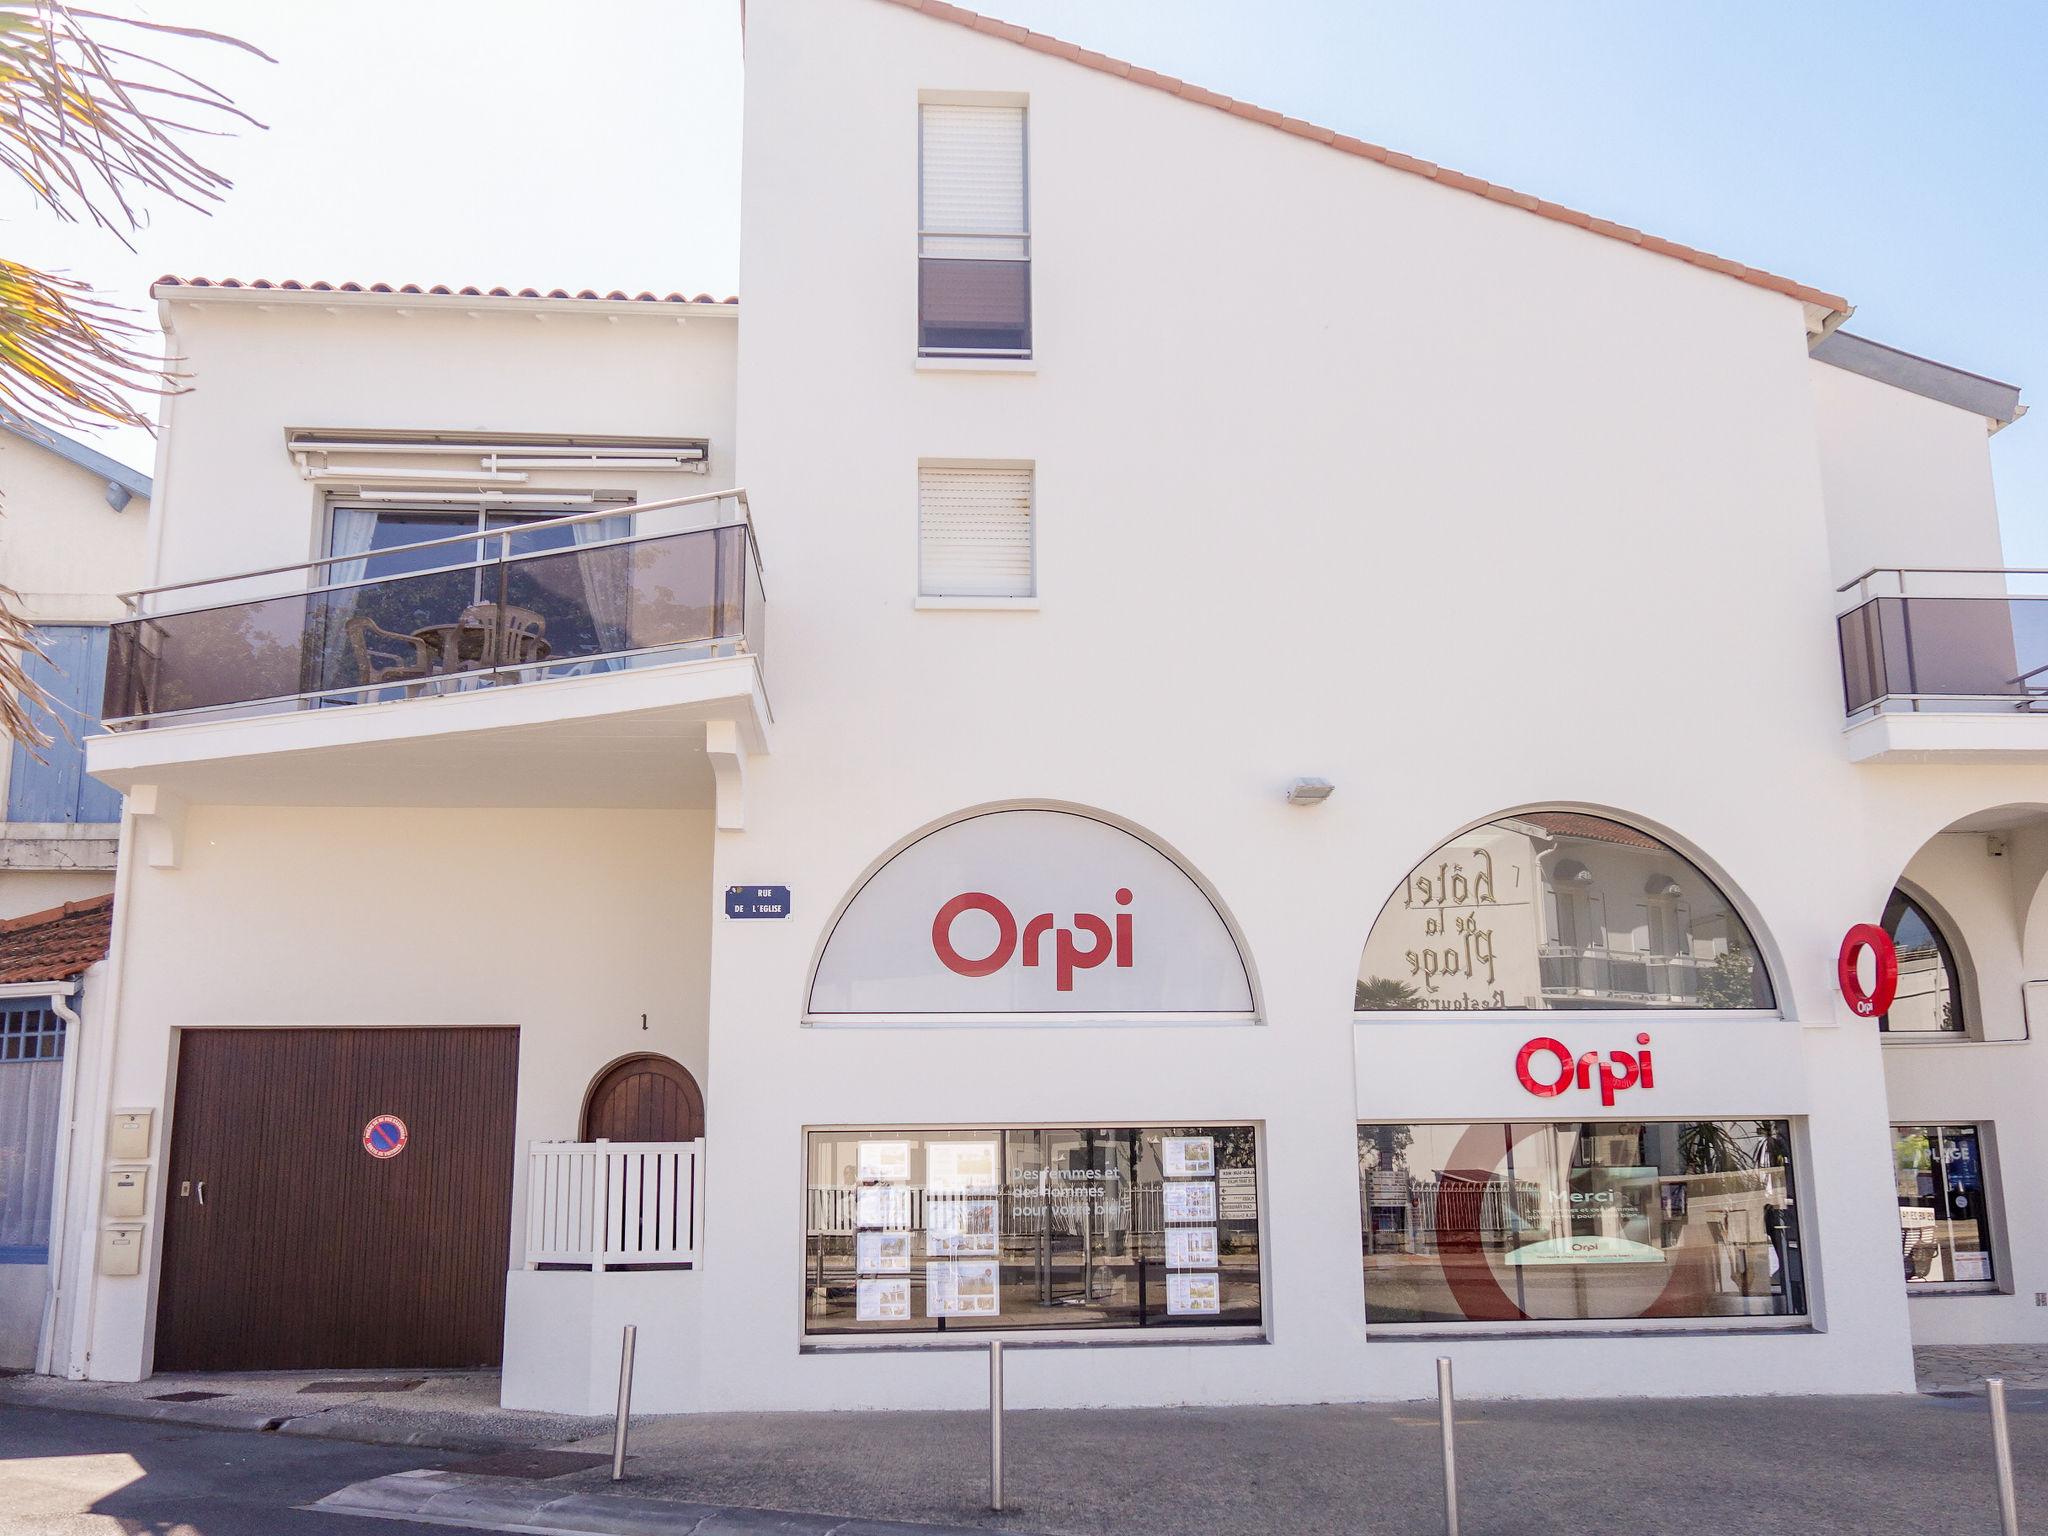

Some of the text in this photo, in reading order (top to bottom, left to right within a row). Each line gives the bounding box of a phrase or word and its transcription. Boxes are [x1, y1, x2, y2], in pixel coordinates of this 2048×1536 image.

[757, 888, 772, 898] RUE
[734, 904, 782, 913] DE L'EGLISE
[932, 888, 1134, 991] Orpi
[641, 1013, 649, 1031] 1
[1515, 1032, 1655, 1107] Orpi
[1012, 1166, 1121, 1180] Des femmes et
[1012, 1186, 1039, 1199] des
[1547, 1188, 1615, 1204] Merci
[1012, 1205, 1048, 1219] pour
[1052, 1203, 1091, 1217] votre
[1571, 1242, 1599, 1253] Orpi
